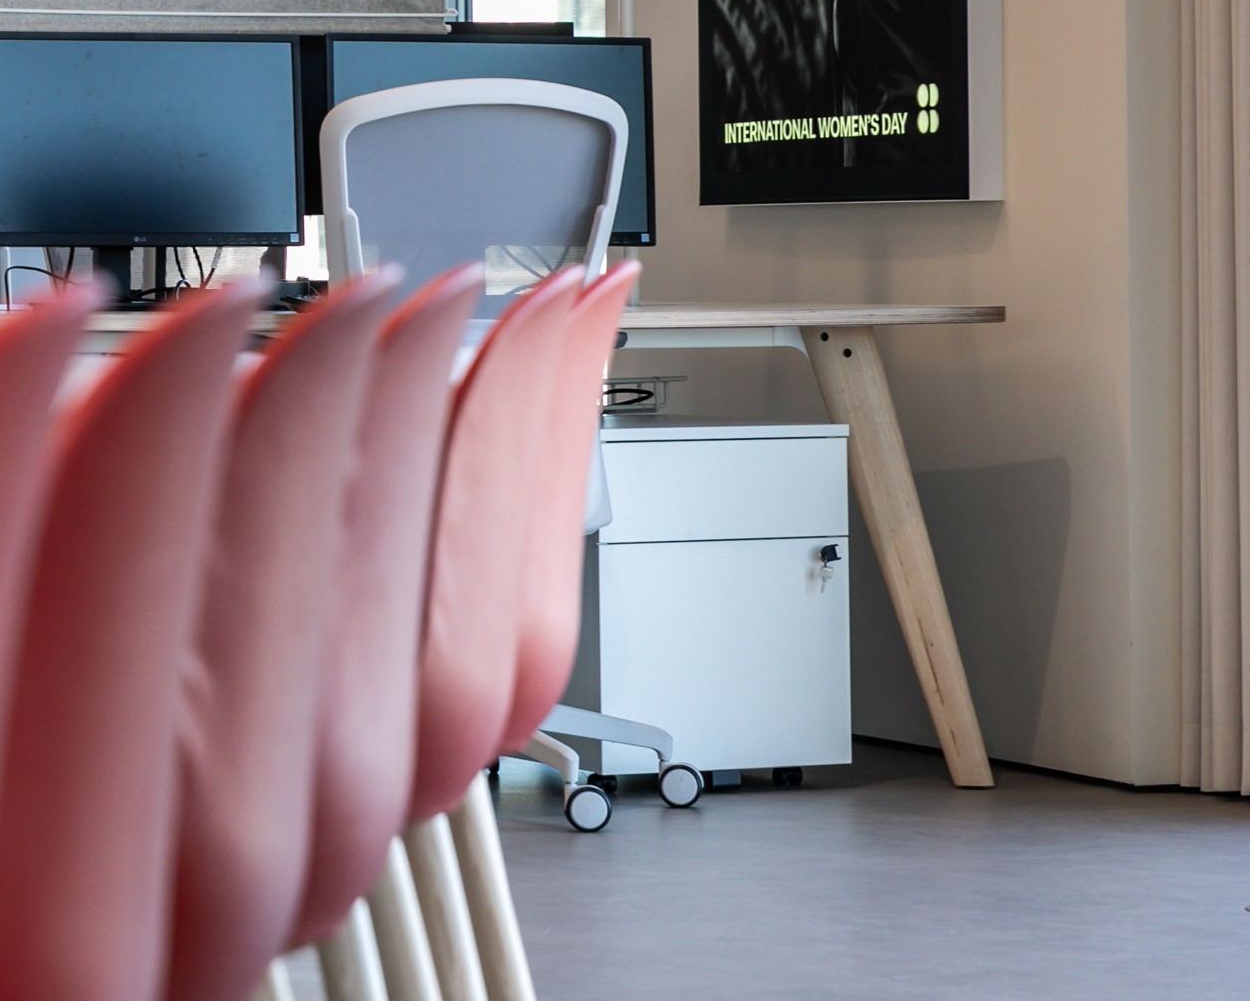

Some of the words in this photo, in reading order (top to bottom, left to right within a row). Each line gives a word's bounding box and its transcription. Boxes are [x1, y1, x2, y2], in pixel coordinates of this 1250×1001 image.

[724, 118, 817, 144] INTERNATIONAL
[817, 114, 880, 138] WOMEN'S
[881, 112, 909, 135] DAY
